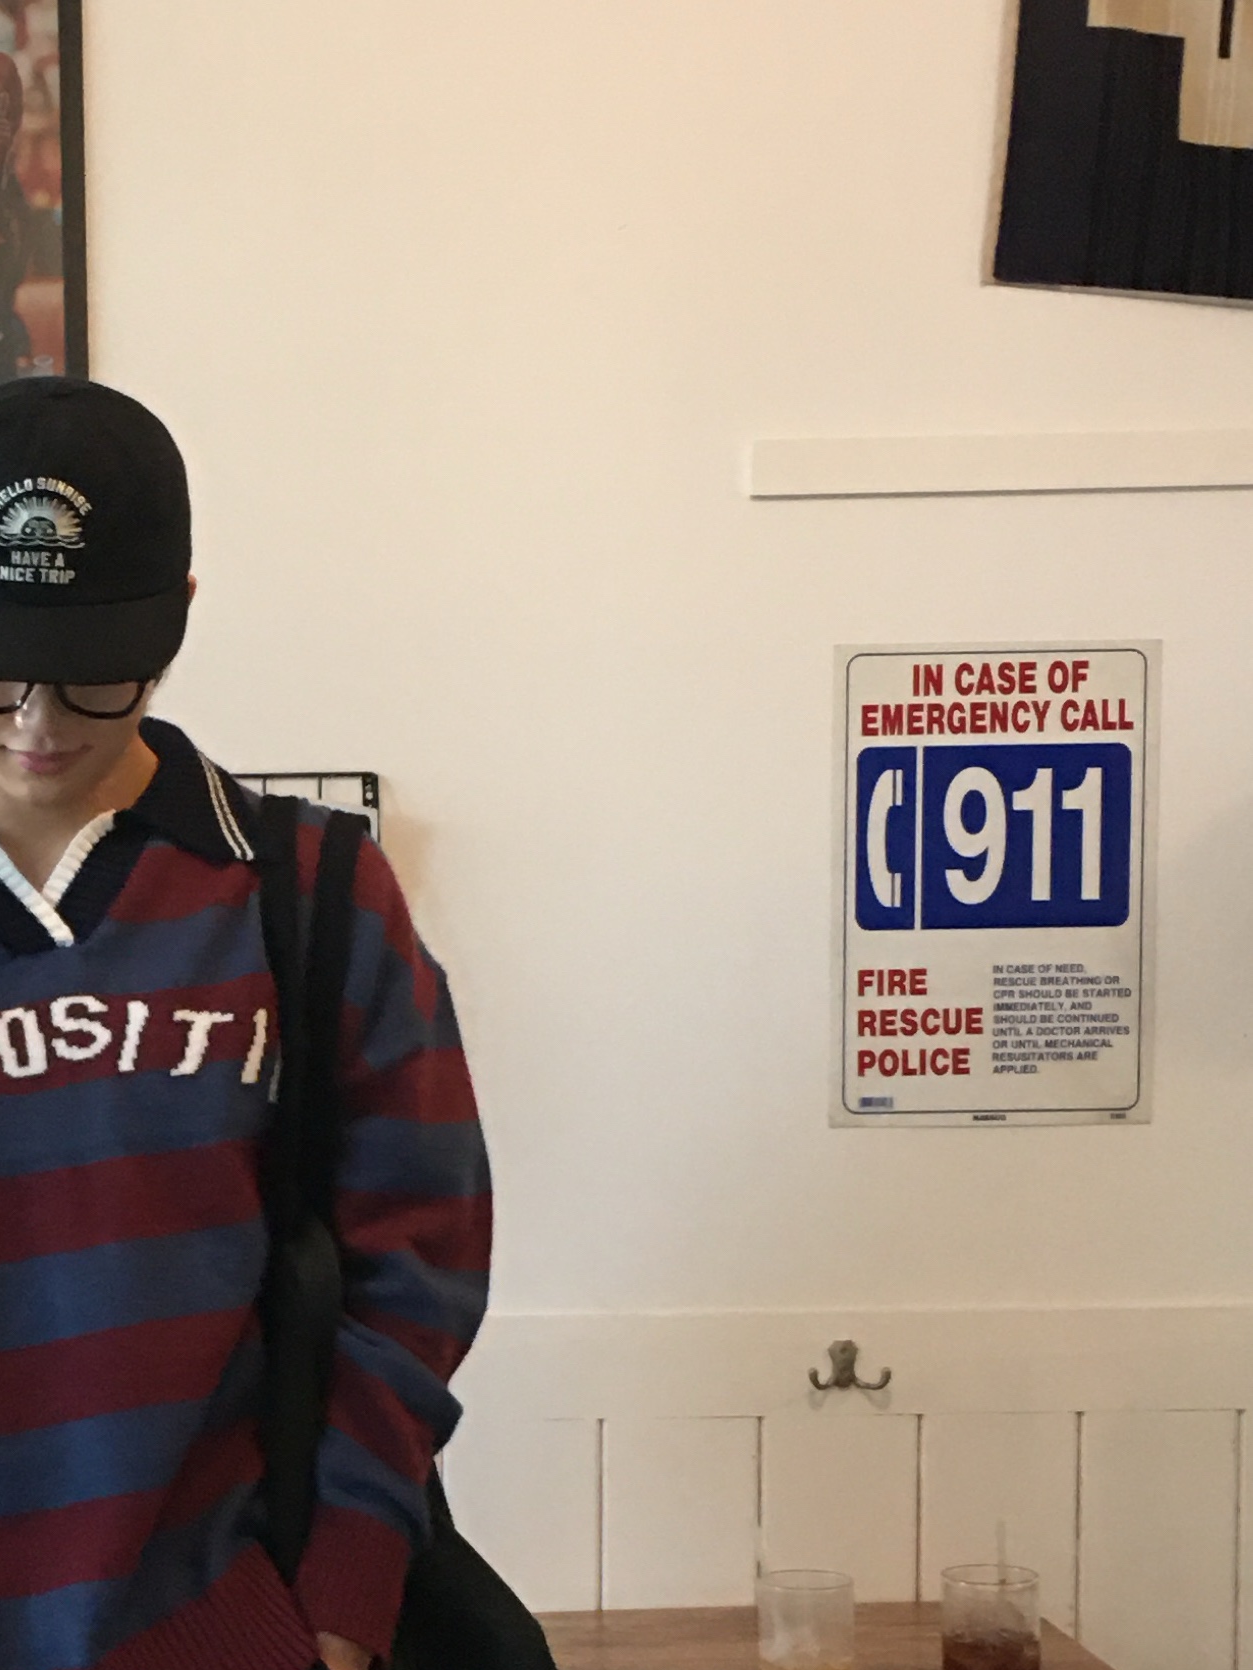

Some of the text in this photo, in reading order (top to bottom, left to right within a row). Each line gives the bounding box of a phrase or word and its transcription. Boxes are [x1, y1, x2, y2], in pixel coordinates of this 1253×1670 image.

[11, 551, 65, 567] HAVE A
[0, 565, 76, 584] NICE TRIP
[913, 660, 1090, 697] IN CASE OF
[860, 698, 1134, 737] EMERGENCY CALL
[943, 766, 1103, 905] 911
[992, 964, 1004, 974] IN
[1006, 964, 1035, 974] CASE
[1037, 964, 1052, 973] OF
[857, 968, 928, 997] FIRE
[993, 975, 1120, 986] RESCUE BREATHING OR
[993, 988, 1132, 999] CPR SHOULD BE STARTED
[1070, 1001, 1093, 1011] AND
[857, 1007, 984, 1037] RESCUE
[993, 1013, 1120, 1024] SHOULD BE CONTINUED
[992, 1026, 1131, 1037] UNTIL A DOCTOR ARRIVES
[992, 1039, 1114, 1049] OR UNTIL MECHANICAL
[1076, 1051, 1099, 1060] ARE
[857, 1048, 971, 1077] POLICE
